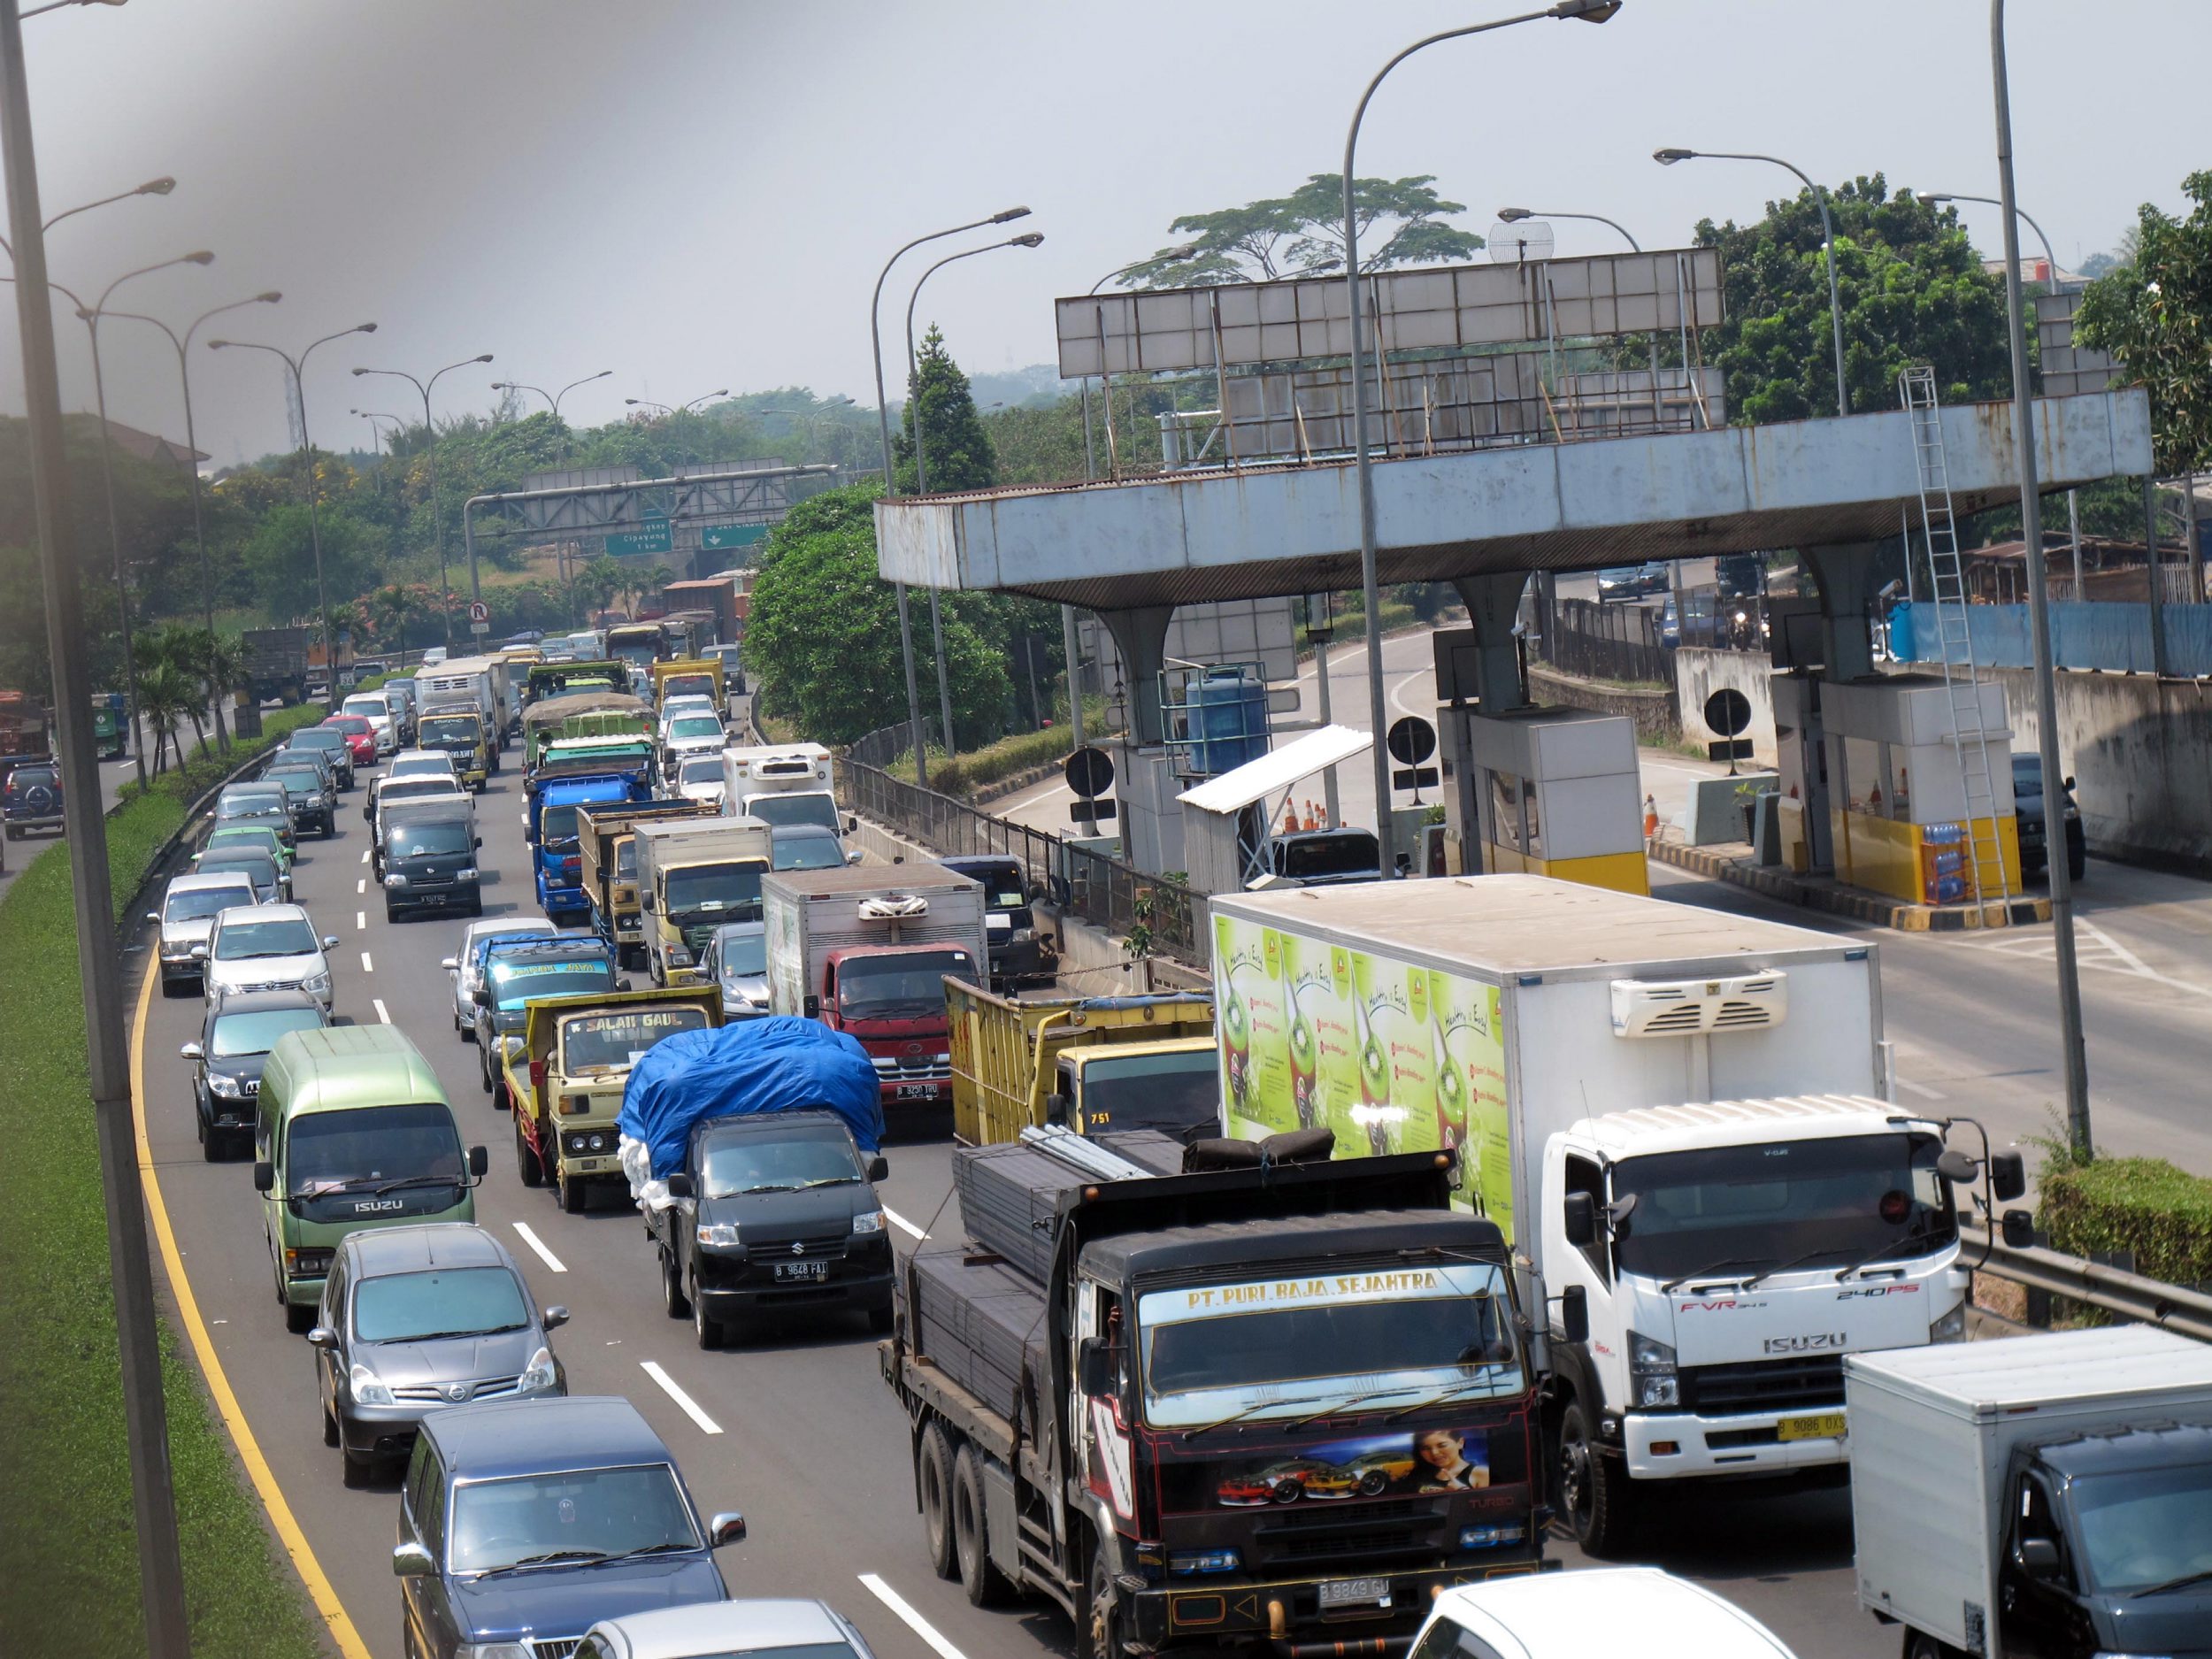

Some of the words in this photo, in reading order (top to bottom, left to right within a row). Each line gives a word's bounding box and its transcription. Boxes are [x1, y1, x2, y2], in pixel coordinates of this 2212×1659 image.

[623, 533, 665, 543] Cipayung
[642, 1012, 682, 1026] GAUL
[1091, 1112, 1110, 1125] 751
[355, 1200, 403, 1212] ISUZU
[776, 1266, 782, 1277] B
[787, 1264, 809, 1275] 9648
[1764, 1331, 1847, 1354] ISUZU
[1778, 1421, 1786, 1434] B
[1793, 1418, 1819, 1432] 9086
[1469, 1495, 1516, 1509] TURBO
[1319, 1586, 1328, 1601] B
[1333, 1581, 1368, 1599] 9849
[1372, 1578, 1389, 1594] GU
